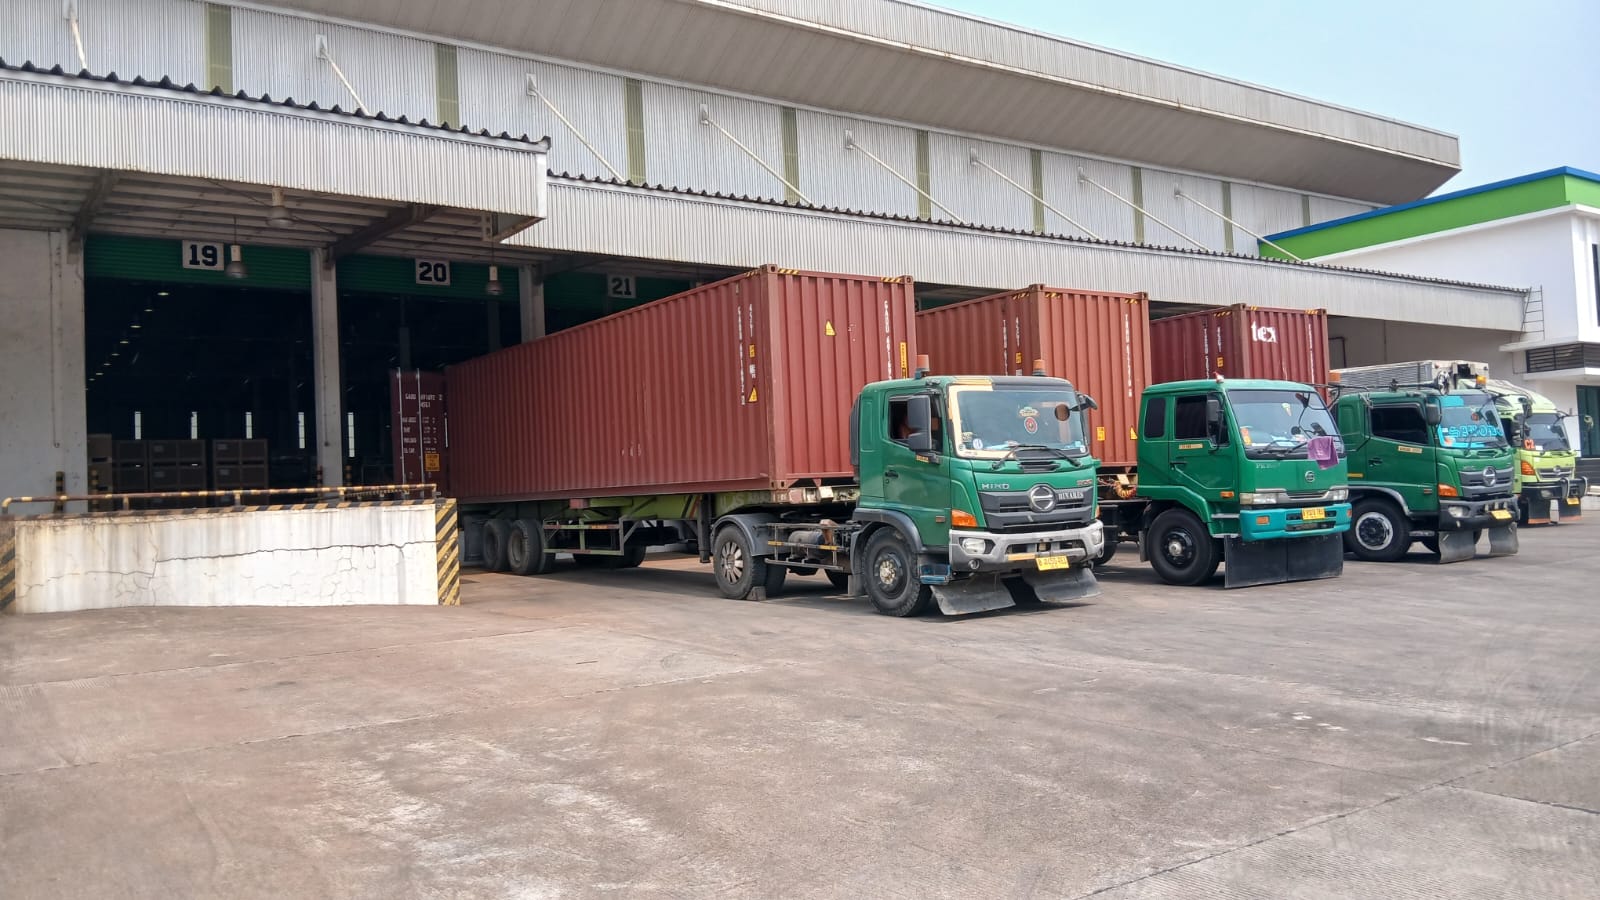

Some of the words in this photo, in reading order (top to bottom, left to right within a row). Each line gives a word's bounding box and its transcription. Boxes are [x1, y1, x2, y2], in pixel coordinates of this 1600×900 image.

[189, 244, 218, 267] 19
[419, 261, 447, 282] 20
[611, 277, 632, 296] 21
